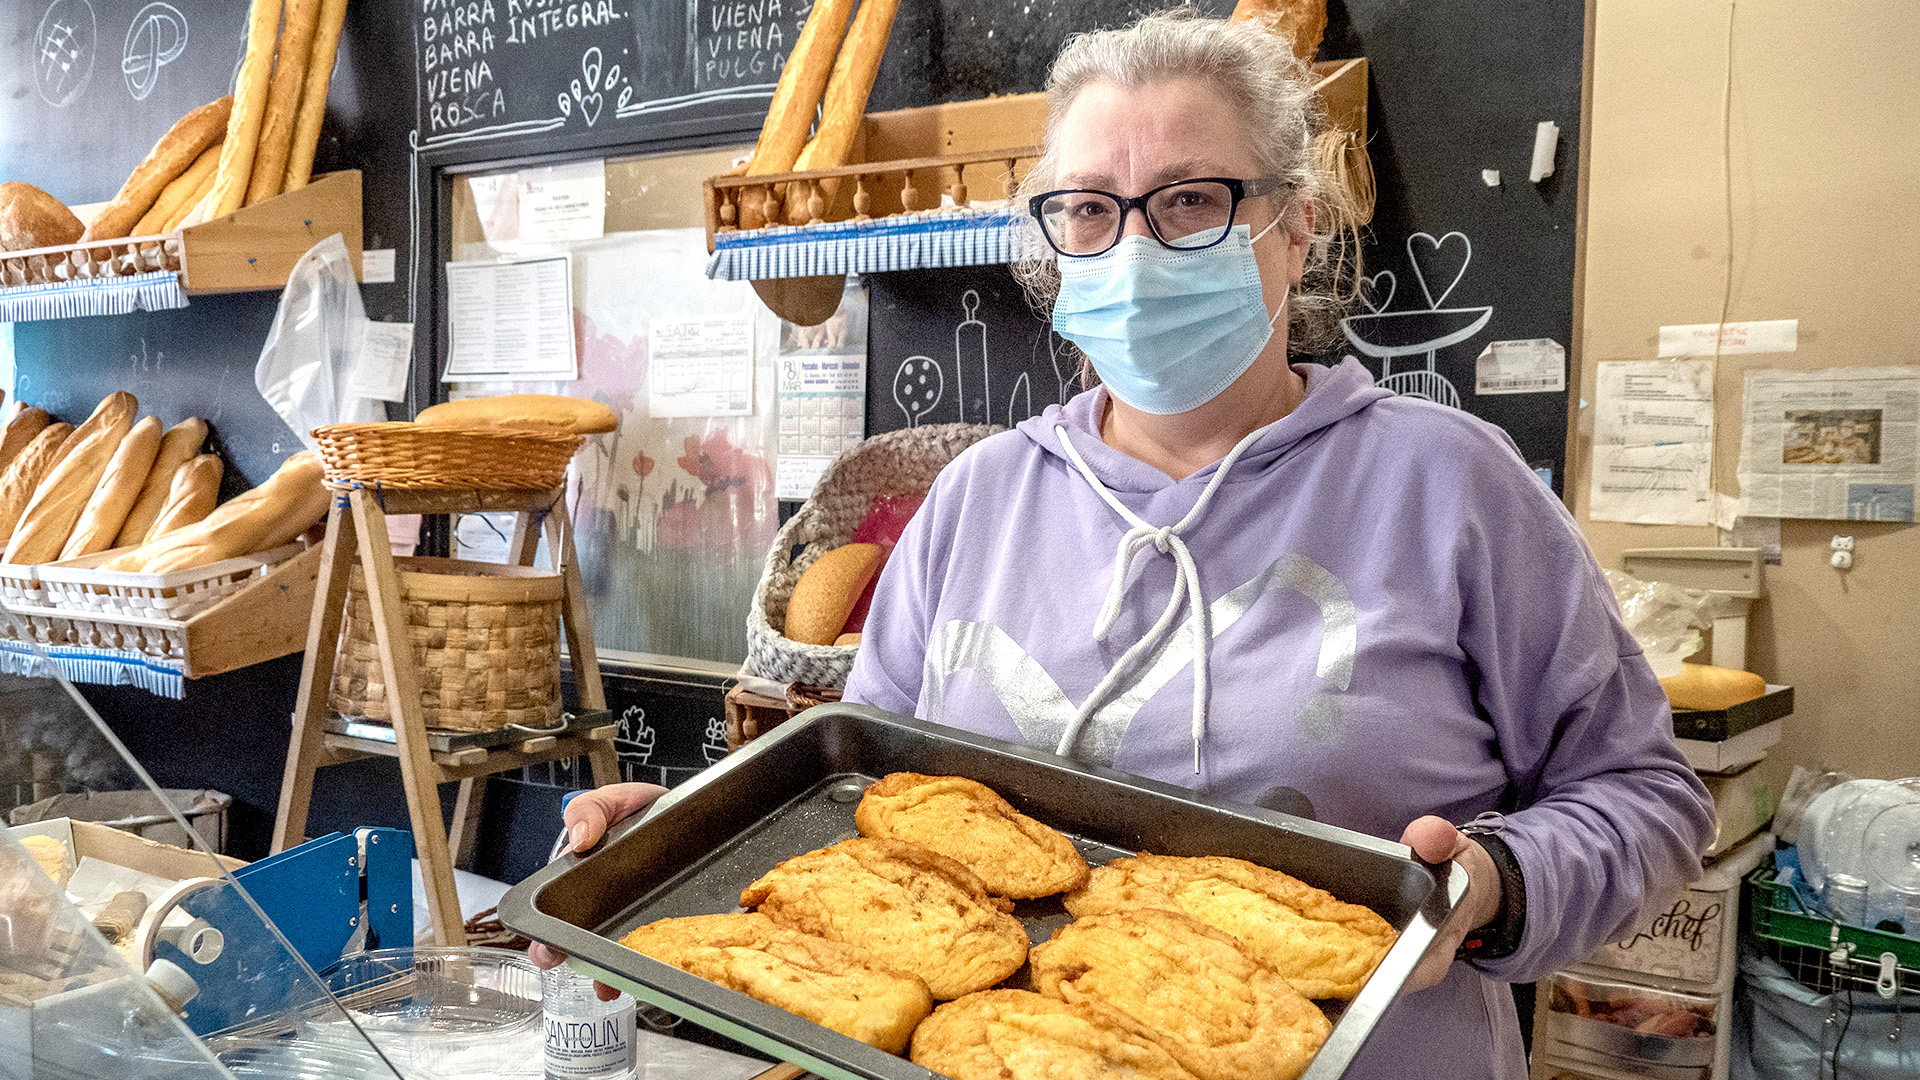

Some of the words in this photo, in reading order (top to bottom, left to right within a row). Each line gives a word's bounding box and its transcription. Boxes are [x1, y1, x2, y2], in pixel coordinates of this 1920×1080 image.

[424, 2, 496, 42] BARRA
[712, 0, 783, 33] VIENA
[425, 26, 496, 71] BARRA
[708, 26, 784, 59] VIENA
[427, 60, 493, 102] VIENA
[430, 87, 506, 131] ROSCA
[545, 1016, 619, 1049] SANTOLÍN
